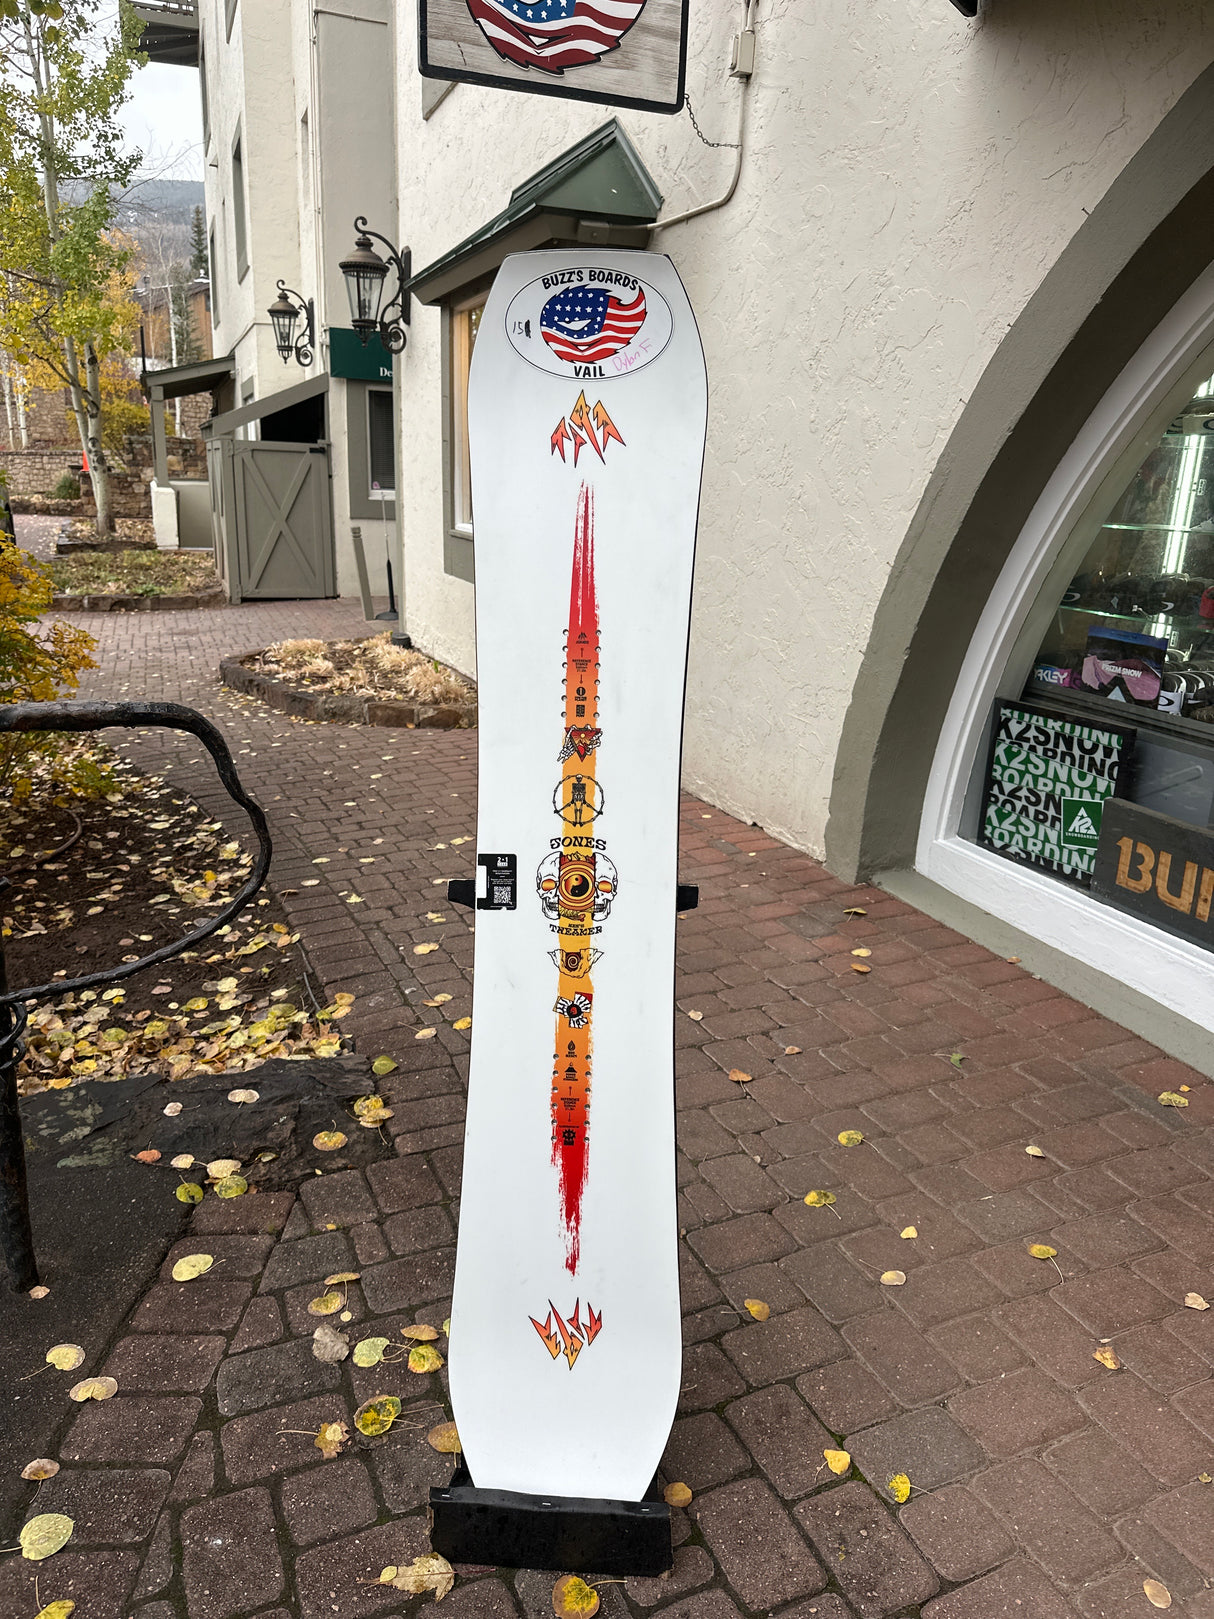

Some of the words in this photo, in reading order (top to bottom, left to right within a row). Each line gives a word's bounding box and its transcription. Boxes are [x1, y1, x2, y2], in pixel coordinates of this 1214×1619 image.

[541, 270, 584, 290] BUZZ'S
[588, 269, 639, 291] BOARDS
[638, 337, 653, 353] F
[573, 365, 606, 378] VAIL
[1034, 668, 1069, 685] AKLEY
[1121, 667, 1143, 679] SNOW
[550, 836, 607, 850] JONES
[1065, 832, 1100, 840] SNOWBOARDIN
